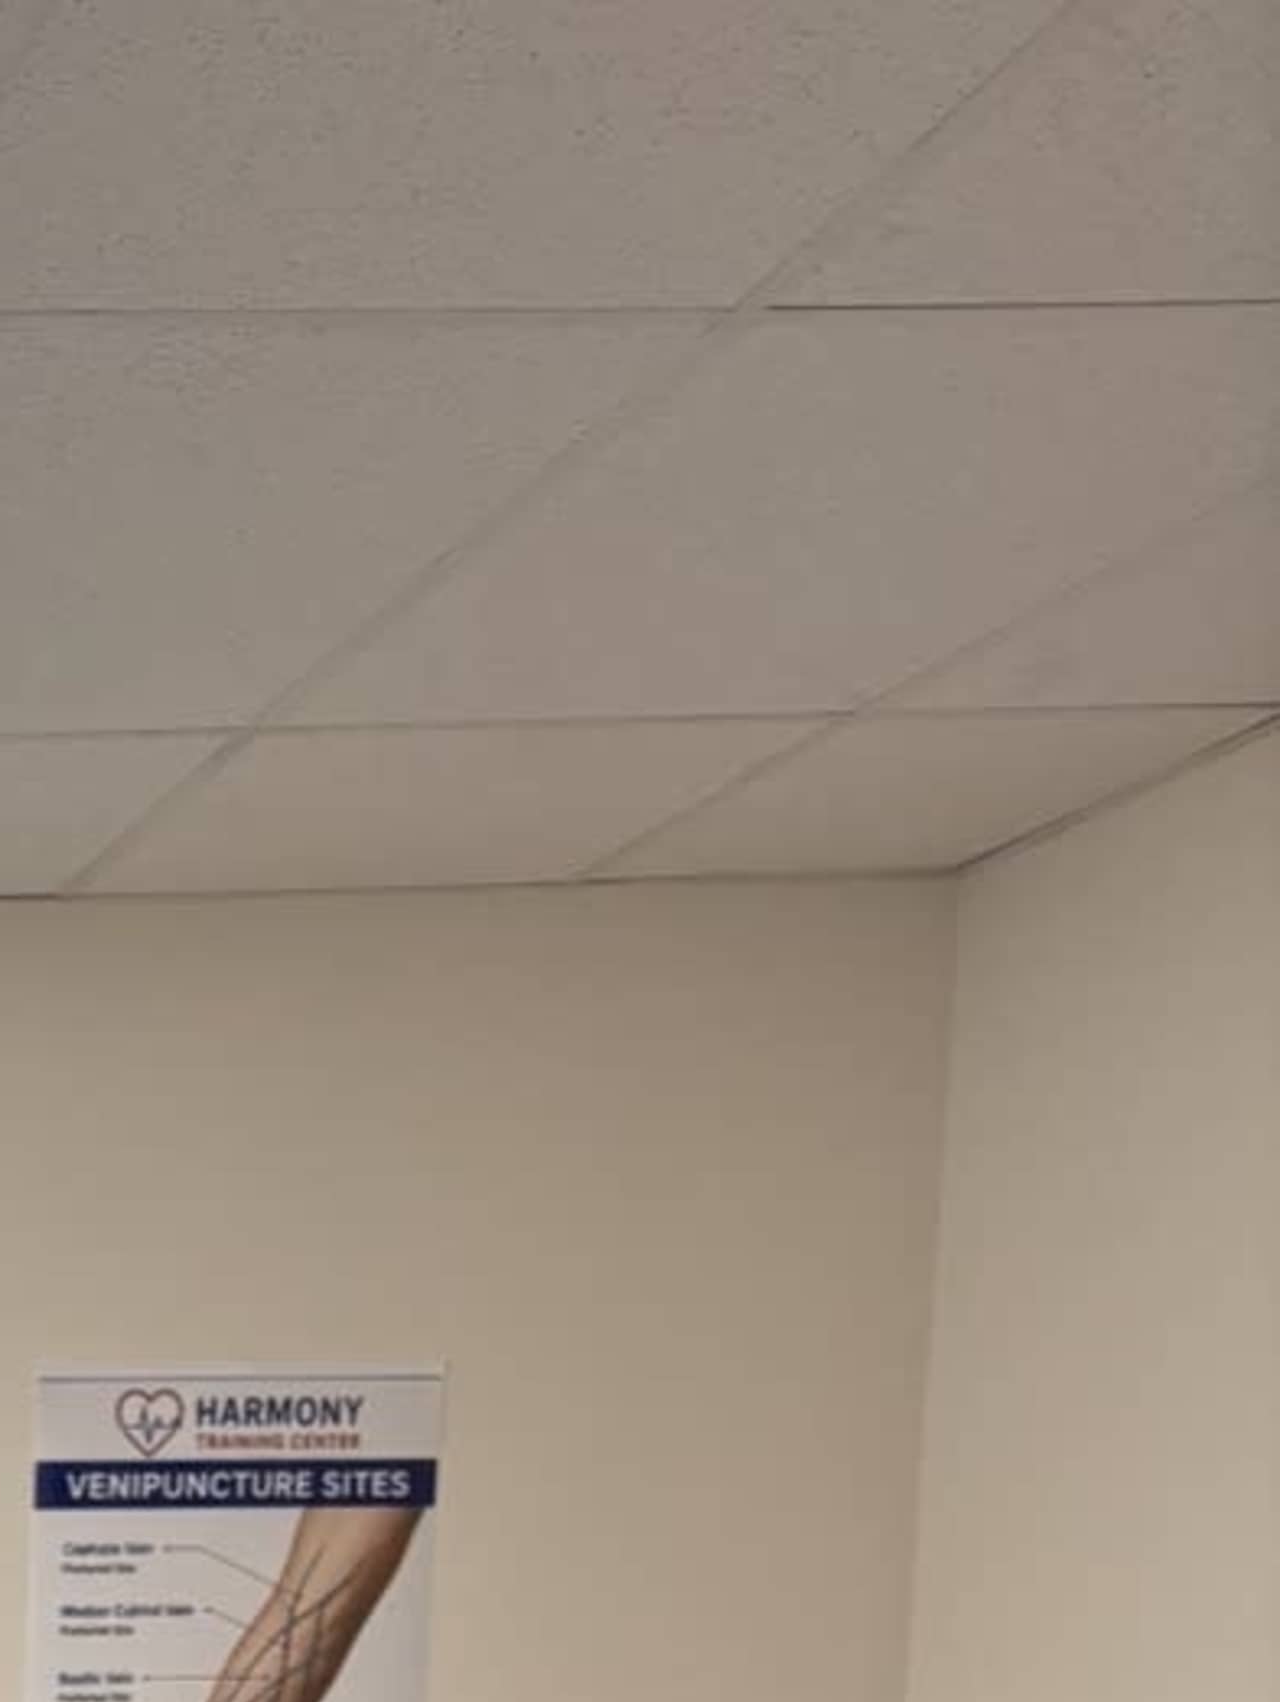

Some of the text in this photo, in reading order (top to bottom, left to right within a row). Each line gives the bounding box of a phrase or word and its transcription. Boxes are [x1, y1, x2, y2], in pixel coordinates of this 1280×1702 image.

[196, 1397, 363, 1427] HARMONY
[196, 1432, 360, 1449] TRAINING CENTER
[66, 1471, 411, 1500] VENIPUNCTURE SITES
